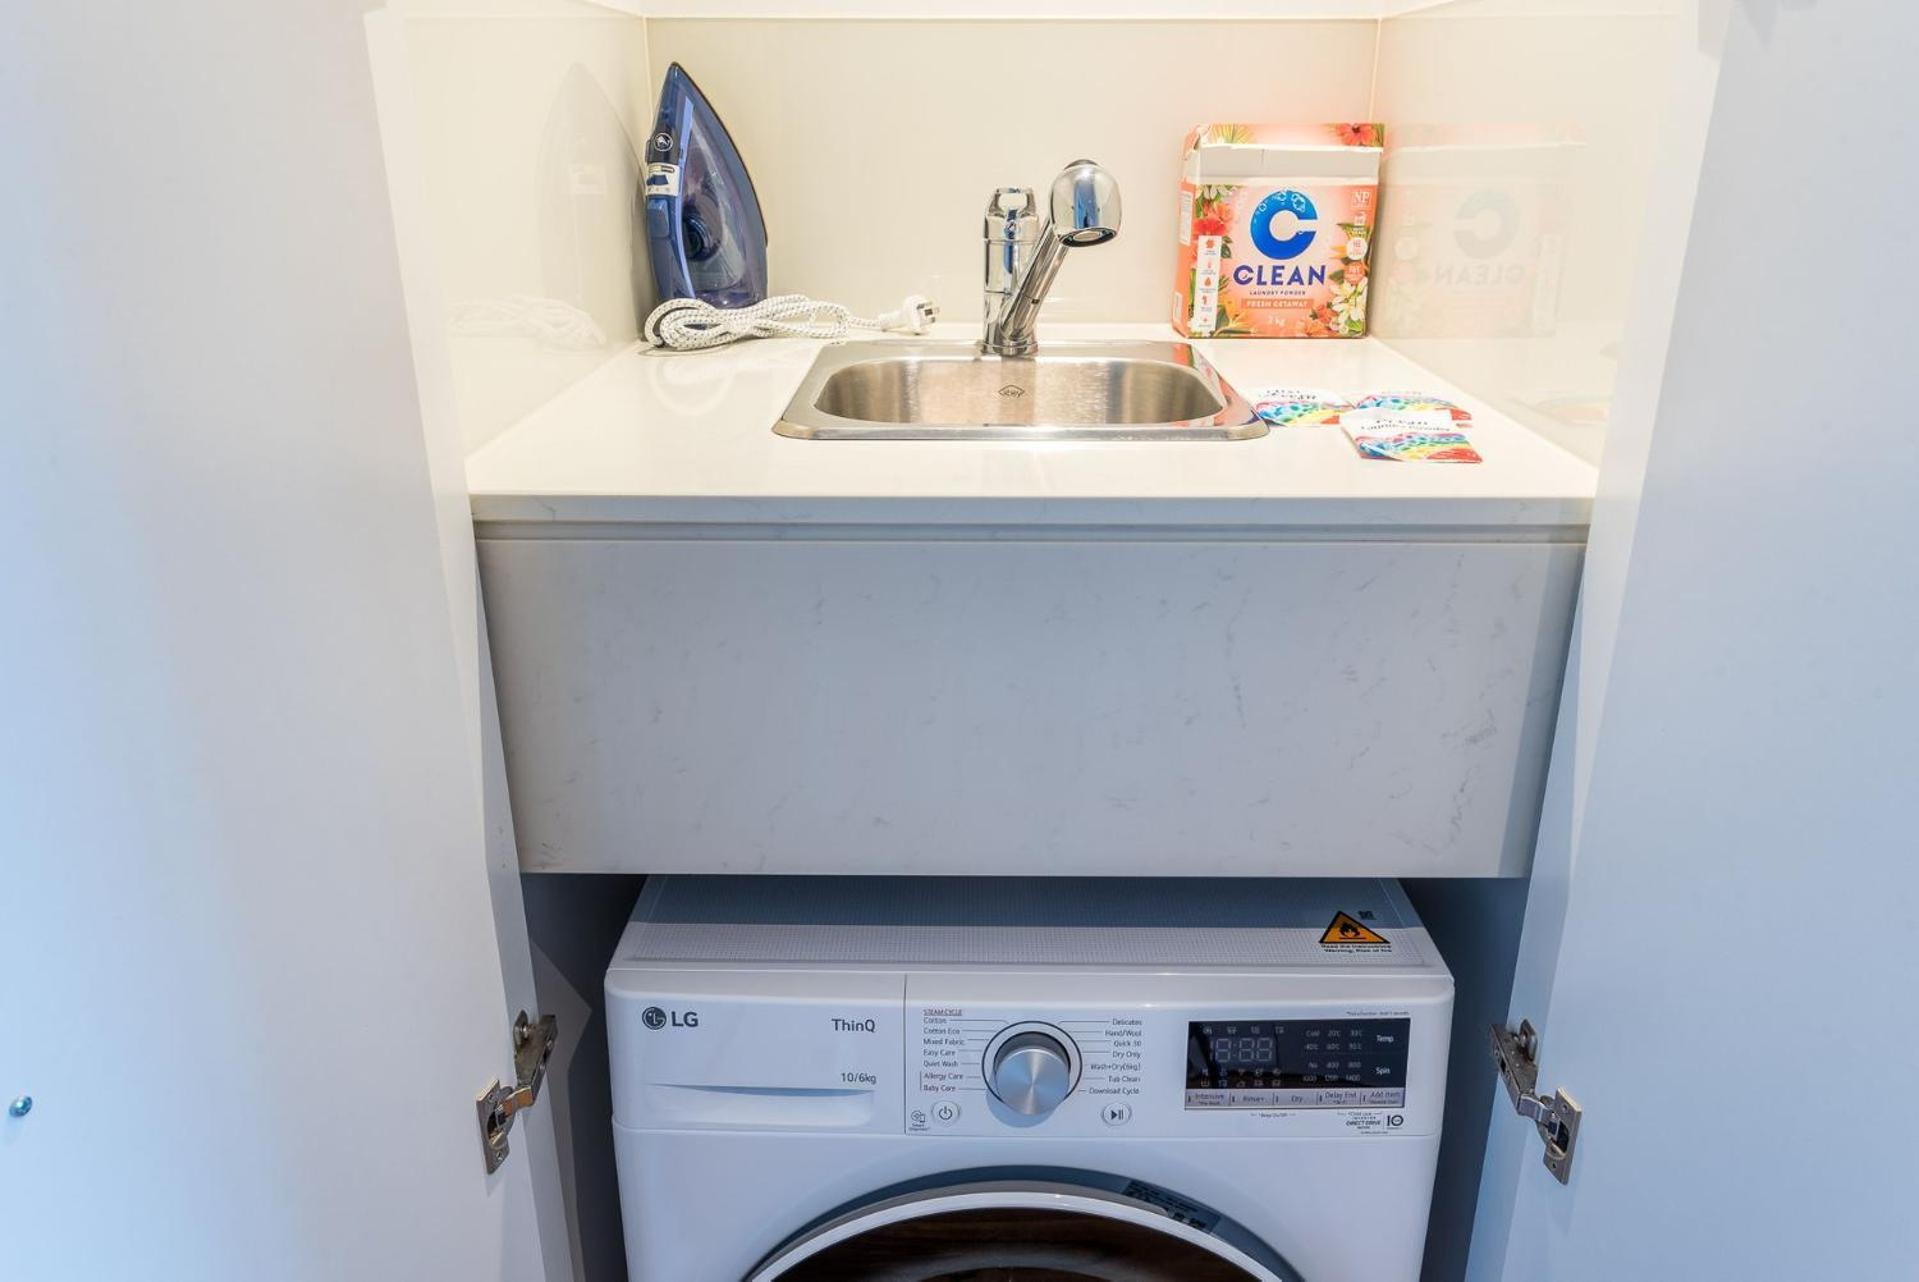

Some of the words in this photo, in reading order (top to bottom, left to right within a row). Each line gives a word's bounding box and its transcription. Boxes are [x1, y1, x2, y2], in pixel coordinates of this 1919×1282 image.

[1233, 265, 1326, 286] CLEAN
[671, 1011, 698, 1027] LG
[1112, 1018, 1142, 1026] Delicates
[831, 1018, 876, 1033] ThinQ
[1376, 1034, 1394, 1043] Temp
[1113, 1040, 1131, 1048] Quick
[1112, 1051, 1124, 1059] Dry
[1376, 1066, 1391, 1076] Spin
[841, 1072, 877, 1084] 10/6kg
[1325, 1091, 1342, 1100] Delay
